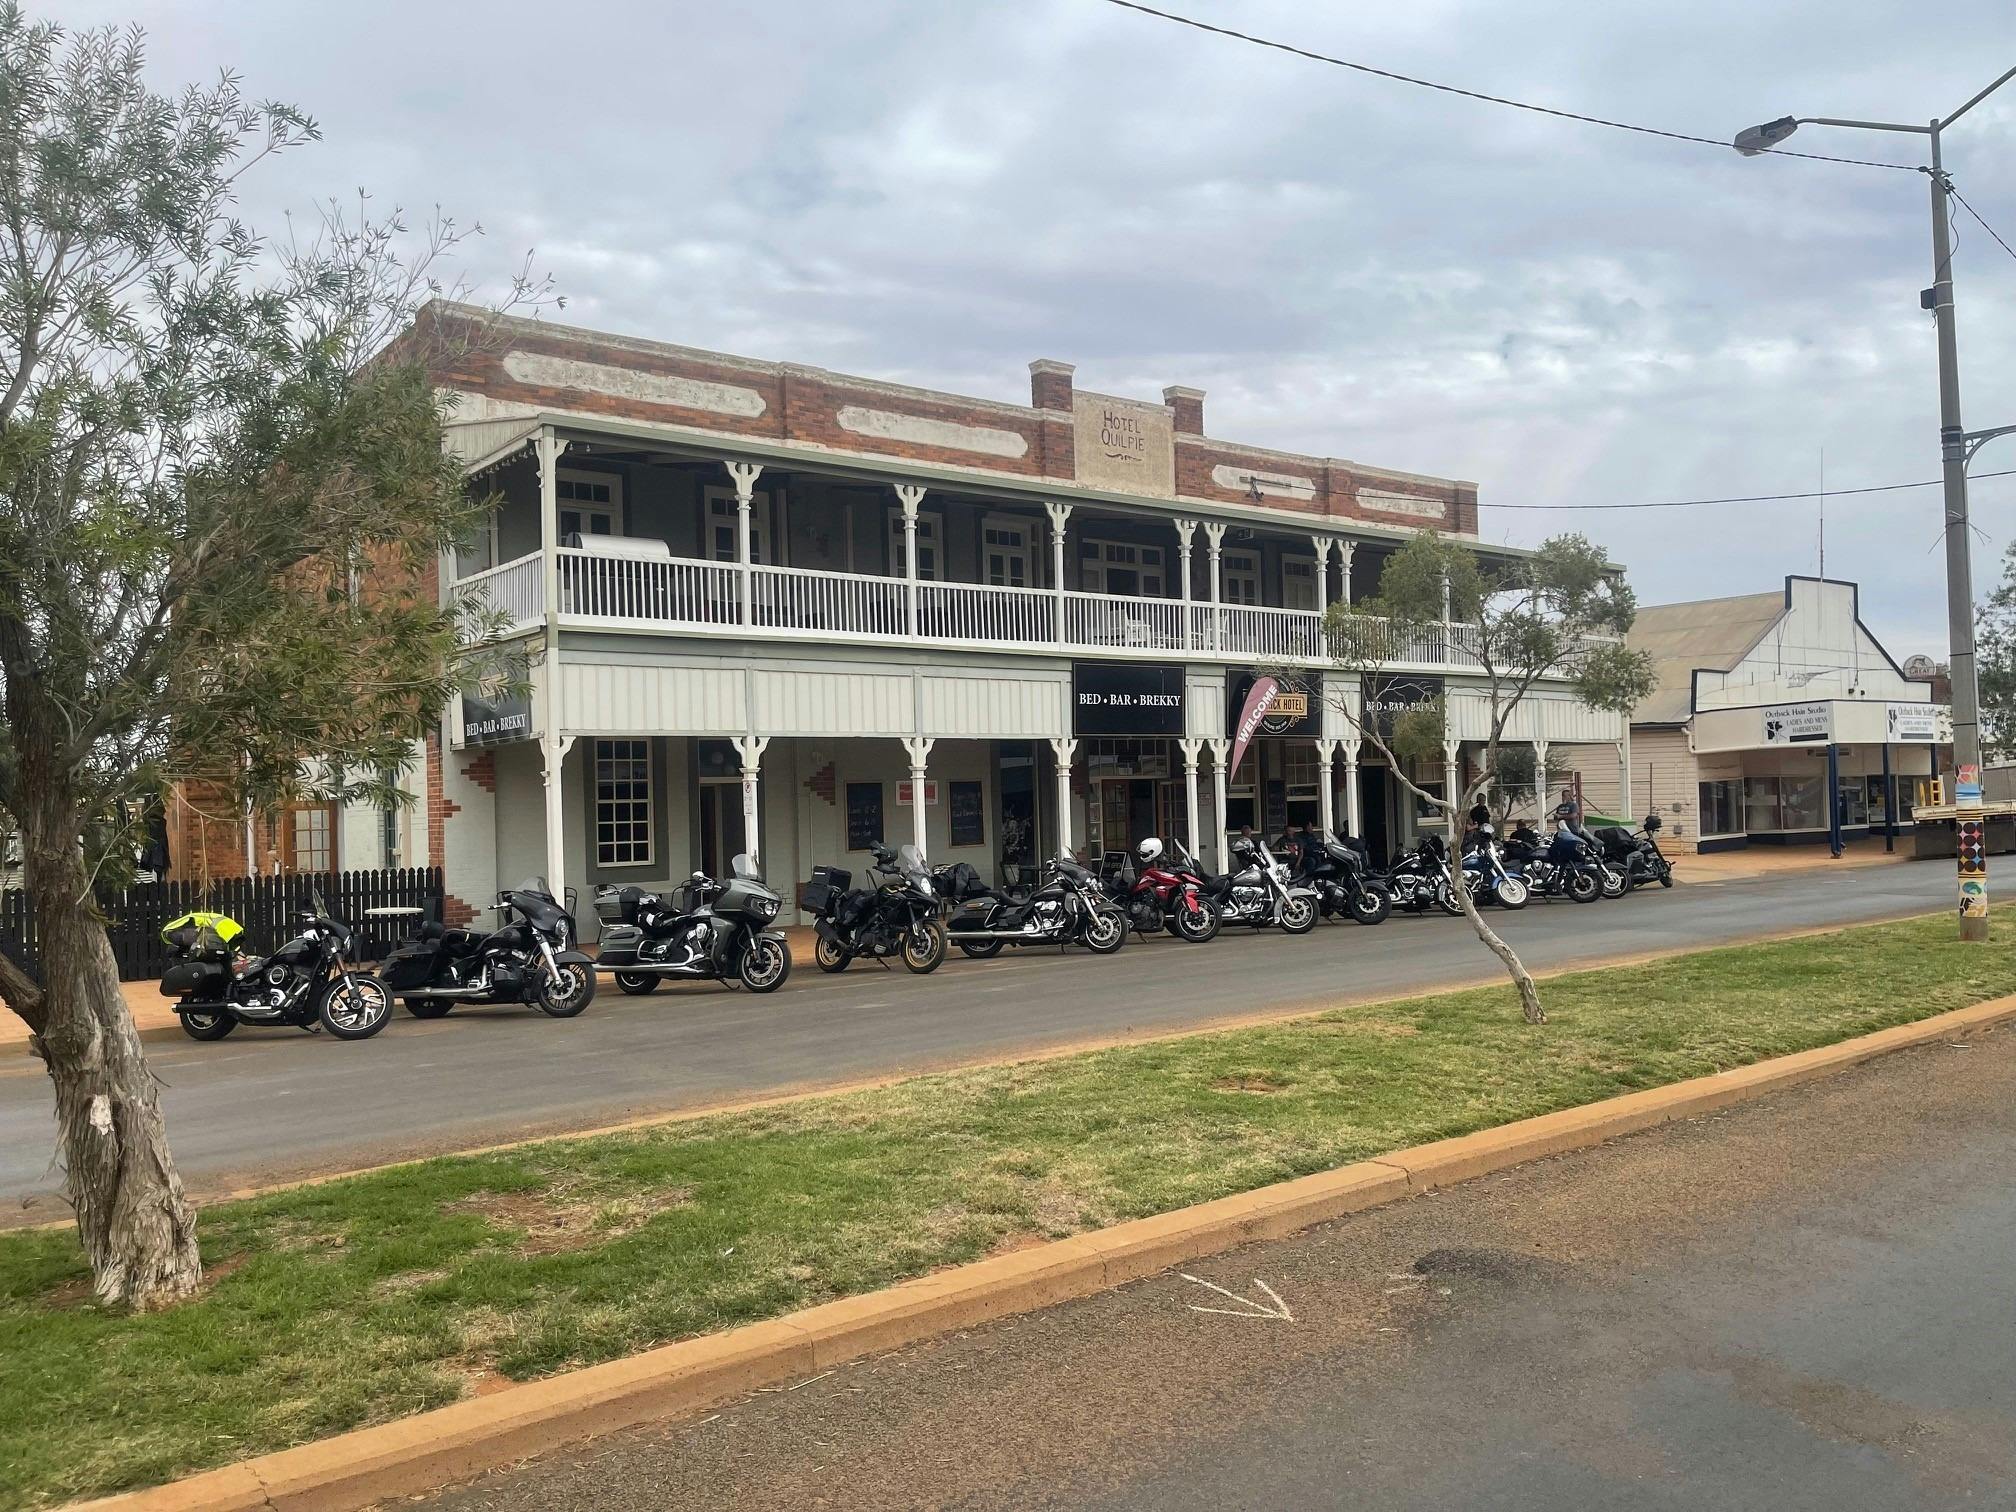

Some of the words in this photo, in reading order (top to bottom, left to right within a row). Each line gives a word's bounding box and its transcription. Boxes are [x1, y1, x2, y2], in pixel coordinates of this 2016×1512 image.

[1103, 410, 1141, 434] HOTEL
[1101, 428, 1145, 451] QUILPIE
[1079, 693, 1101, 705] BED
[1109, 694, 1132, 706] BAR
[1139, 695, 1181, 707] BREKKY
[1283, 699, 1303, 711] HOTEL
[1388, 701, 1405, 712] BAR
[1238, 684, 1278, 743] WELCOME
[466, 722, 479, 737] BED
[483, 719, 496, 734] BAR
[500, 714, 526, 731] BREKKY
